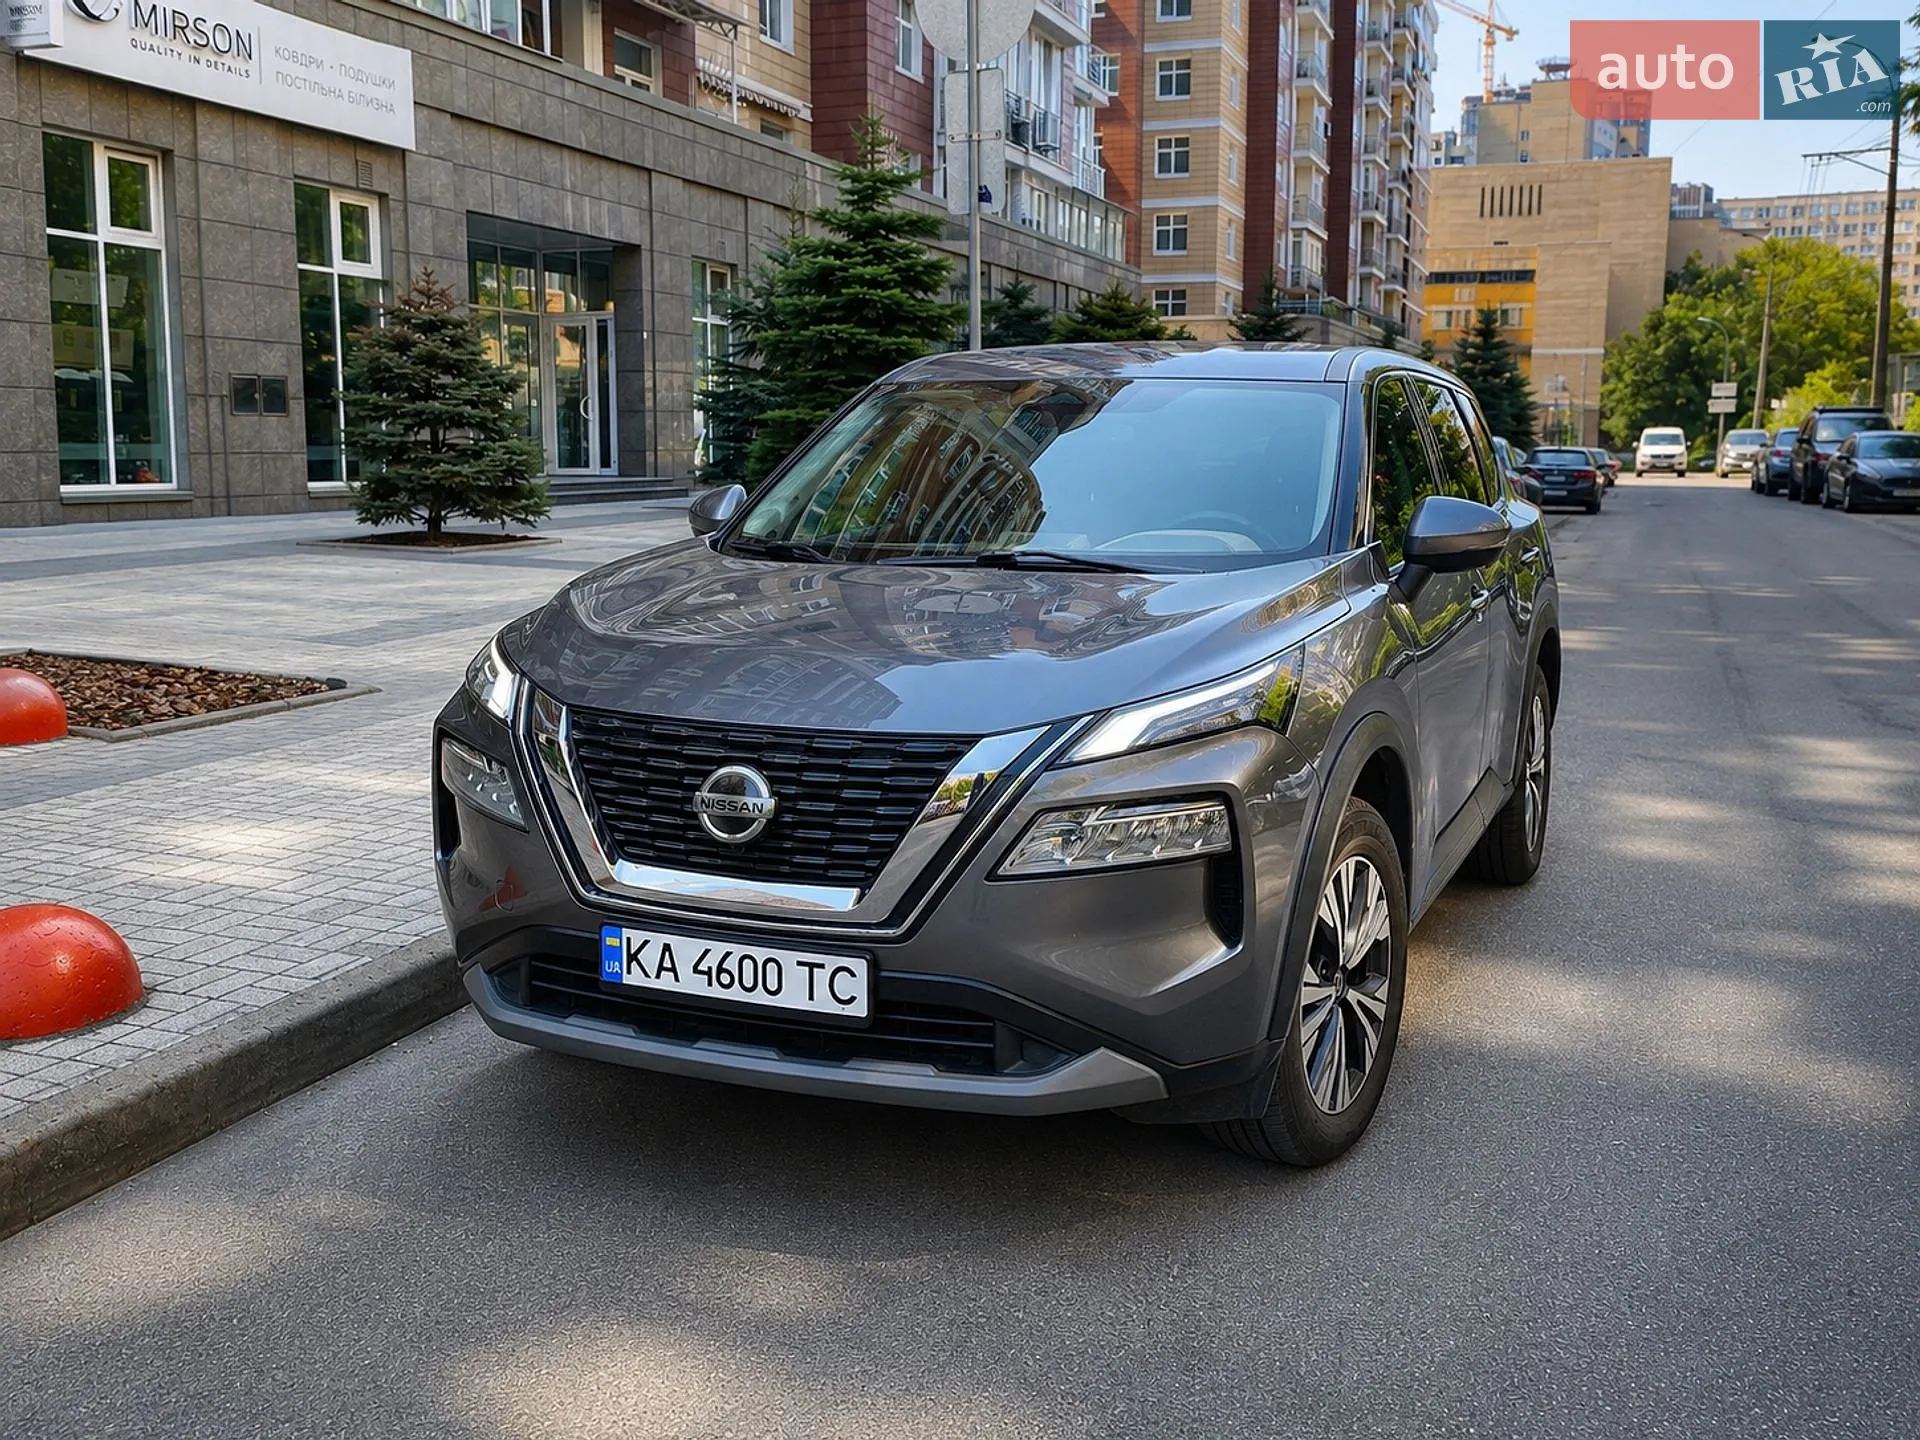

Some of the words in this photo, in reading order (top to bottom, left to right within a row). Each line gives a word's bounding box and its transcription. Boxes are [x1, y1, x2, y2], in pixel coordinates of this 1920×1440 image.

[133, 0, 253, 60] MIRSON
[130, 38, 182, 61] QUALITY
[188, 54, 200, 65] IN
[205, 59, 250, 78] DETAILS
[274, 46, 325, 71] КОВДРИ
[339, 63, 396, 90] ПОДУШКИ
[275, 71, 344, 101] ПОСТІЛЬНА
[347, 90, 396, 114] БІЛИЗНА
[700, 797, 764, 813] NISSAN
[605, 960, 621, 974] UA
[626, 937, 680, 982] KA
[692, 948, 783, 996] 4600
[796, 960, 858, 1006] TC
